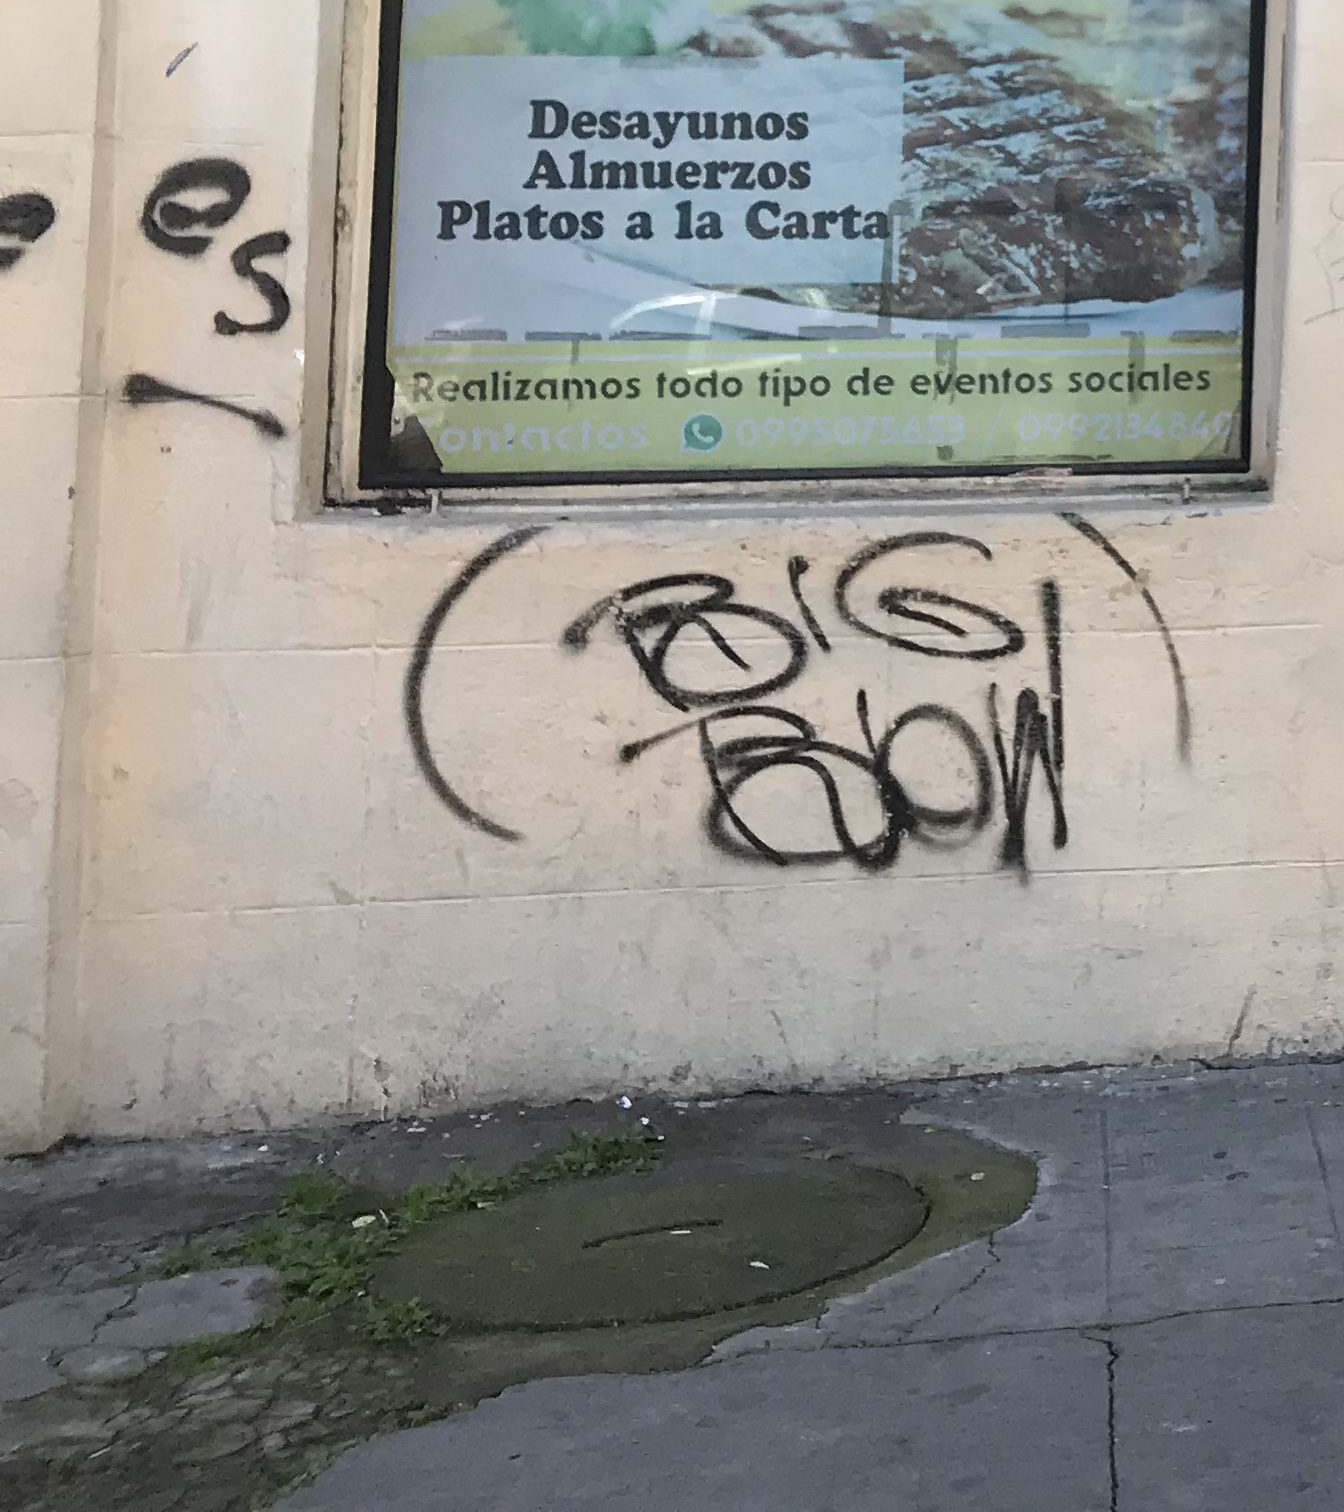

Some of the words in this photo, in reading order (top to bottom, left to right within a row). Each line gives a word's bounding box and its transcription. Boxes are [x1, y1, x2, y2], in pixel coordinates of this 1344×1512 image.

[527, 99, 810, 149] Desayunos
[522, 149, 811, 190] Almuerzos
[436, 200, 604, 240] Platos
[625, 210, 654, 240] a
[674, 200, 723, 240] la
[745, 200, 890, 240] Carta
[411, 370, 641, 403] Realizamos
[657, 369, 744, 400] todo
[758, 369, 831, 406] tipo
[846, 367, 895, 396] de
[910, 367, 1054, 396] eventos
[1067, 363, 1212, 394] sociales
[423, 418, 648, 453] ontactos
